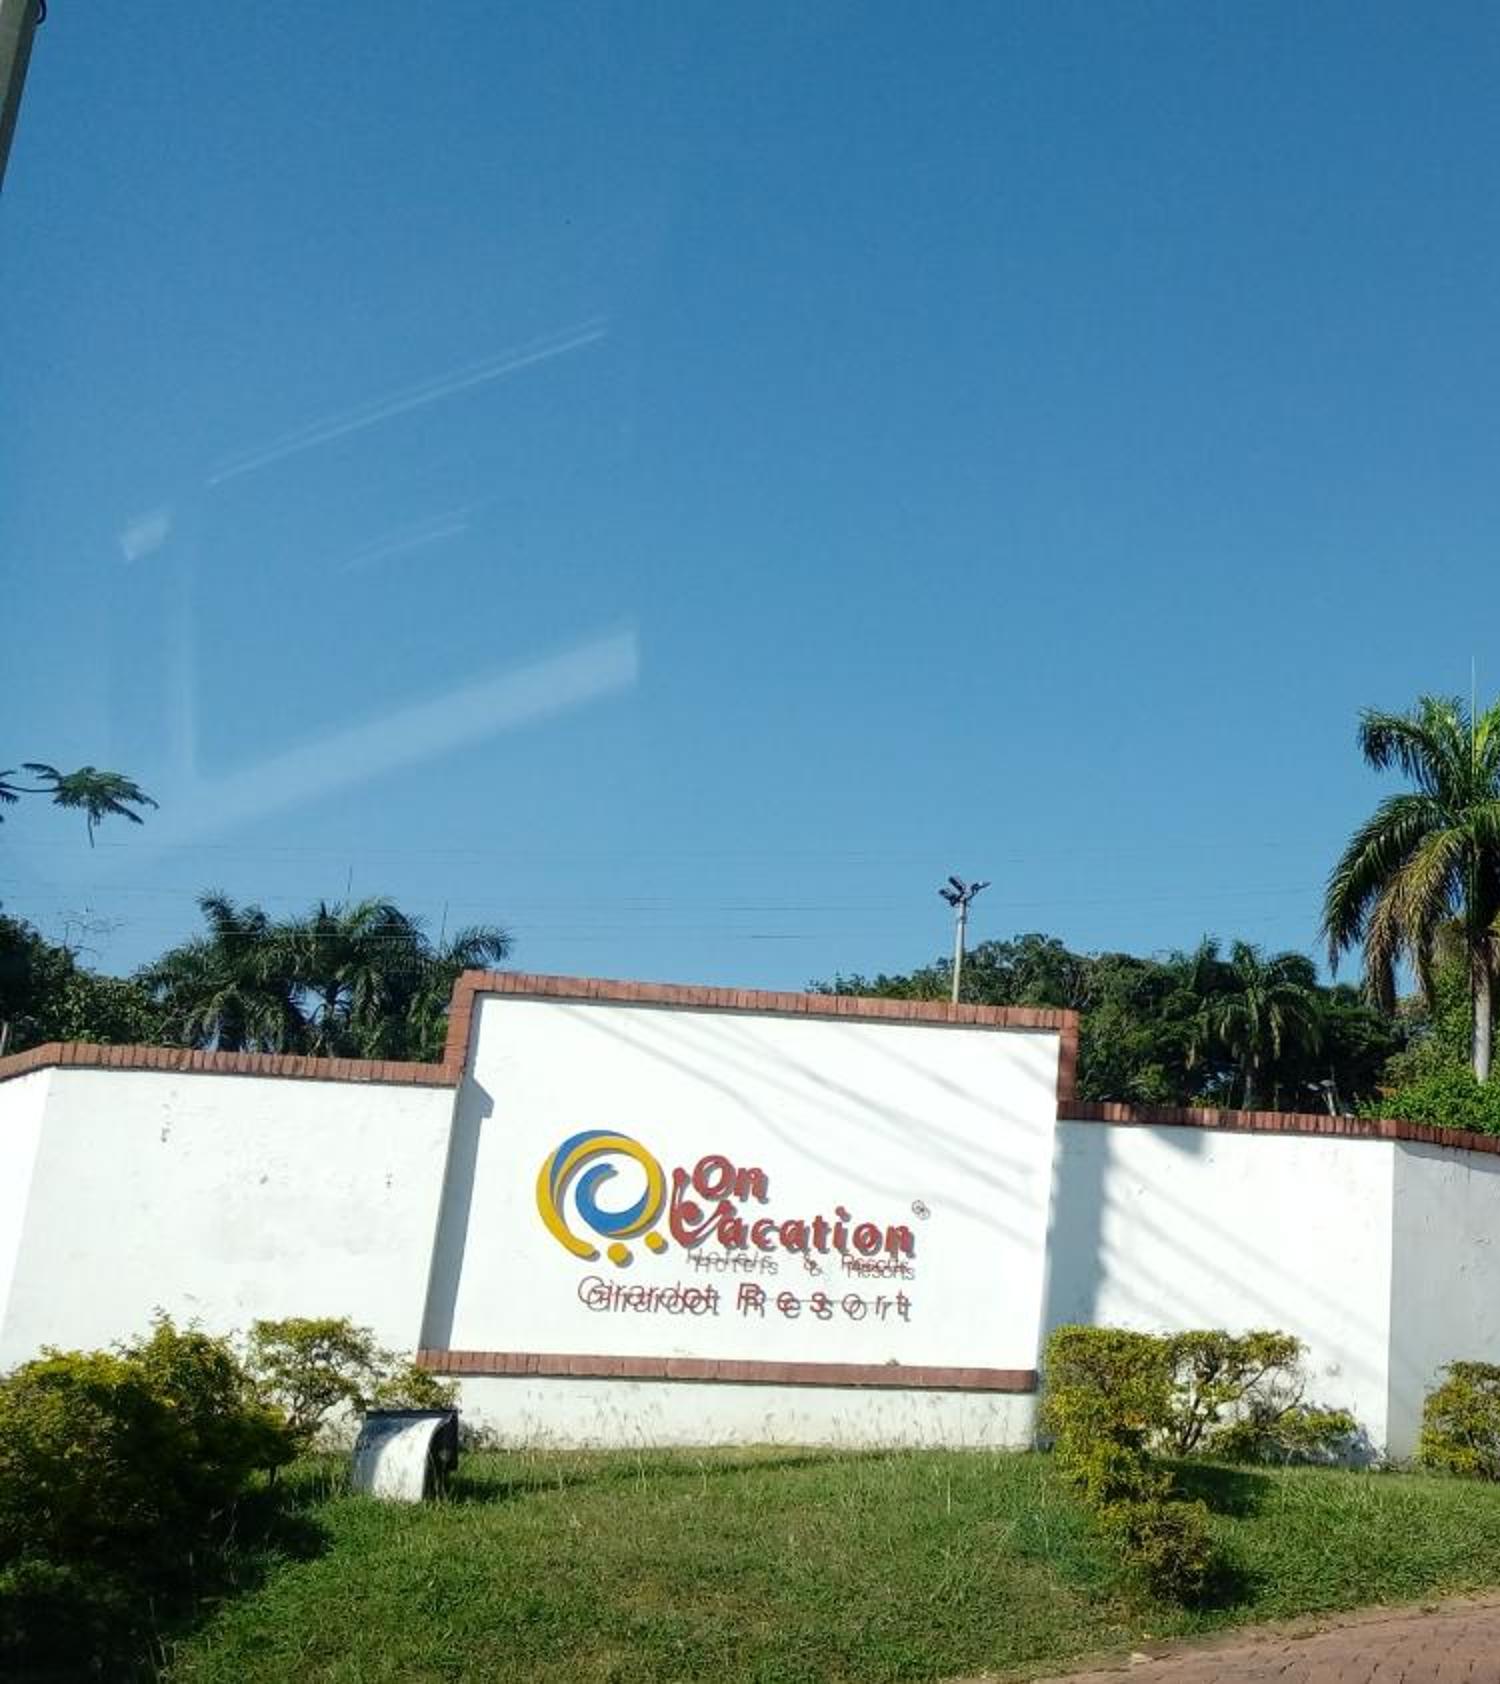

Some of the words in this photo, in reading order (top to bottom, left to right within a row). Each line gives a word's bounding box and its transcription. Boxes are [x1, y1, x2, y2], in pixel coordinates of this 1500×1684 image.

[692, 1155, 768, 1203] On
[669, 1167, 915, 1257] Vacation
[686, 1249, 778, 1275] Hotels
[578, 1276, 721, 1316] Girardot
[737, 1282, 911, 1322] Resort
